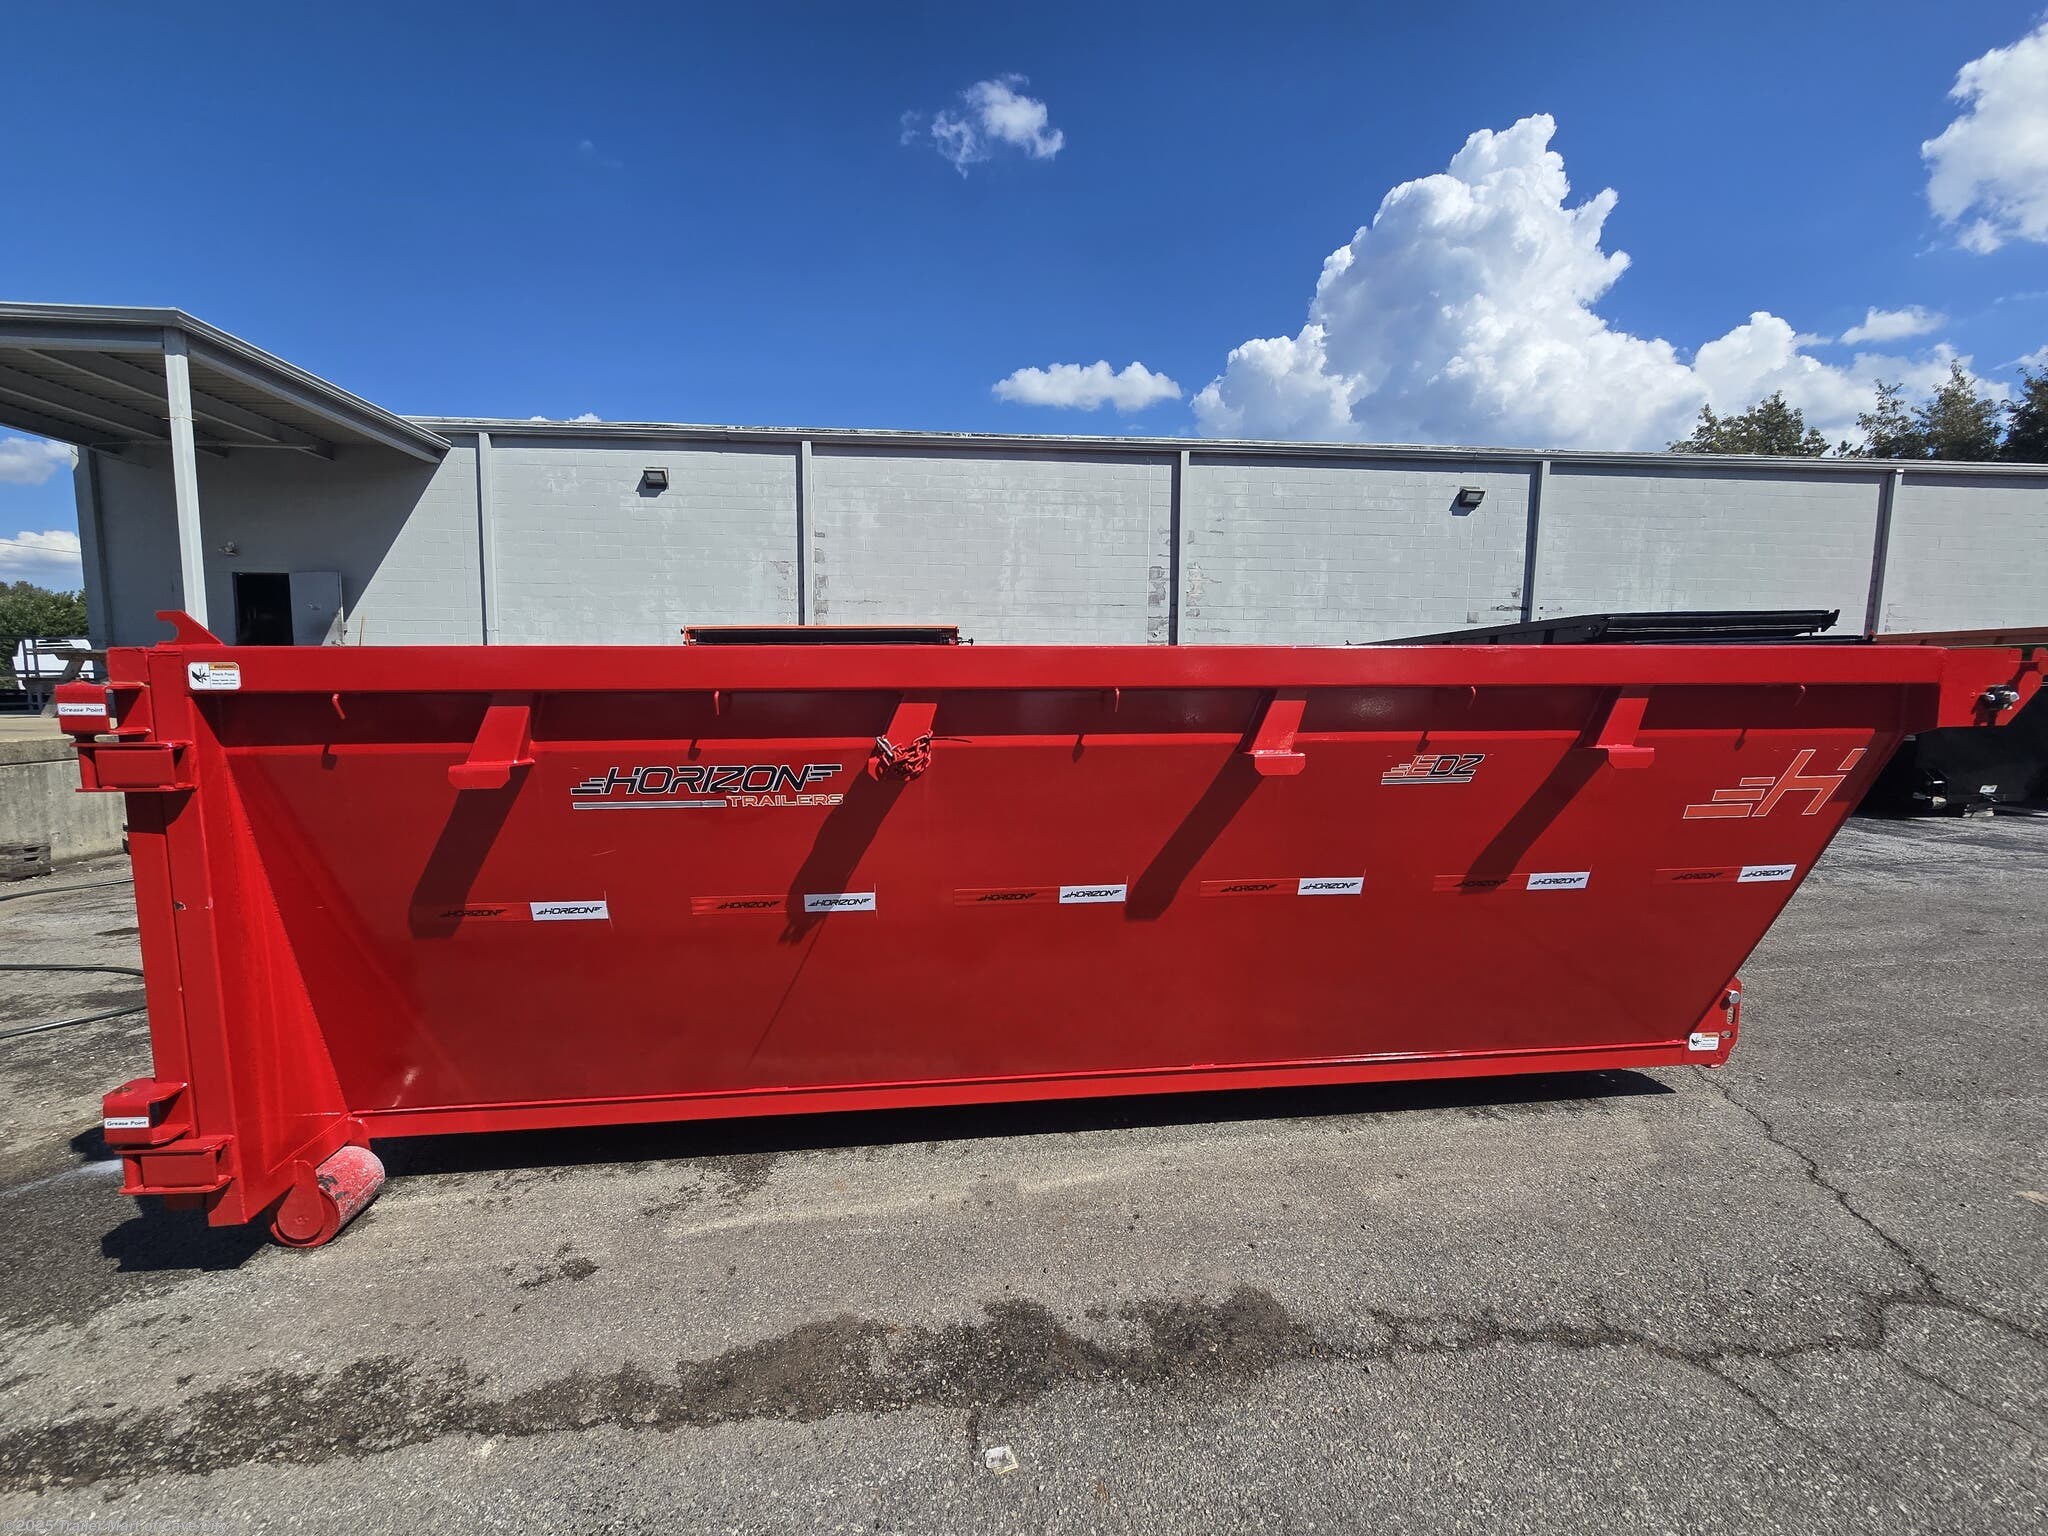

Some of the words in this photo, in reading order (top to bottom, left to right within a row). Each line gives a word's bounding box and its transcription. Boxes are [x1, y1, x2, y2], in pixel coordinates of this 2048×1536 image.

[588, 765, 826, 795] HORIZON
[726, 793, 843, 808] TRAILERS
[1746, 869, 1789, 878] HORIZON
[1304, 882, 1356, 890] HORIZON
[1534, 878, 1582, 886] HORIZON
[1066, 890, 1119, 899] HORIZON
[811, 899, 867, 907] HORIZON
[540, 907, 599, 915] HORIZON
